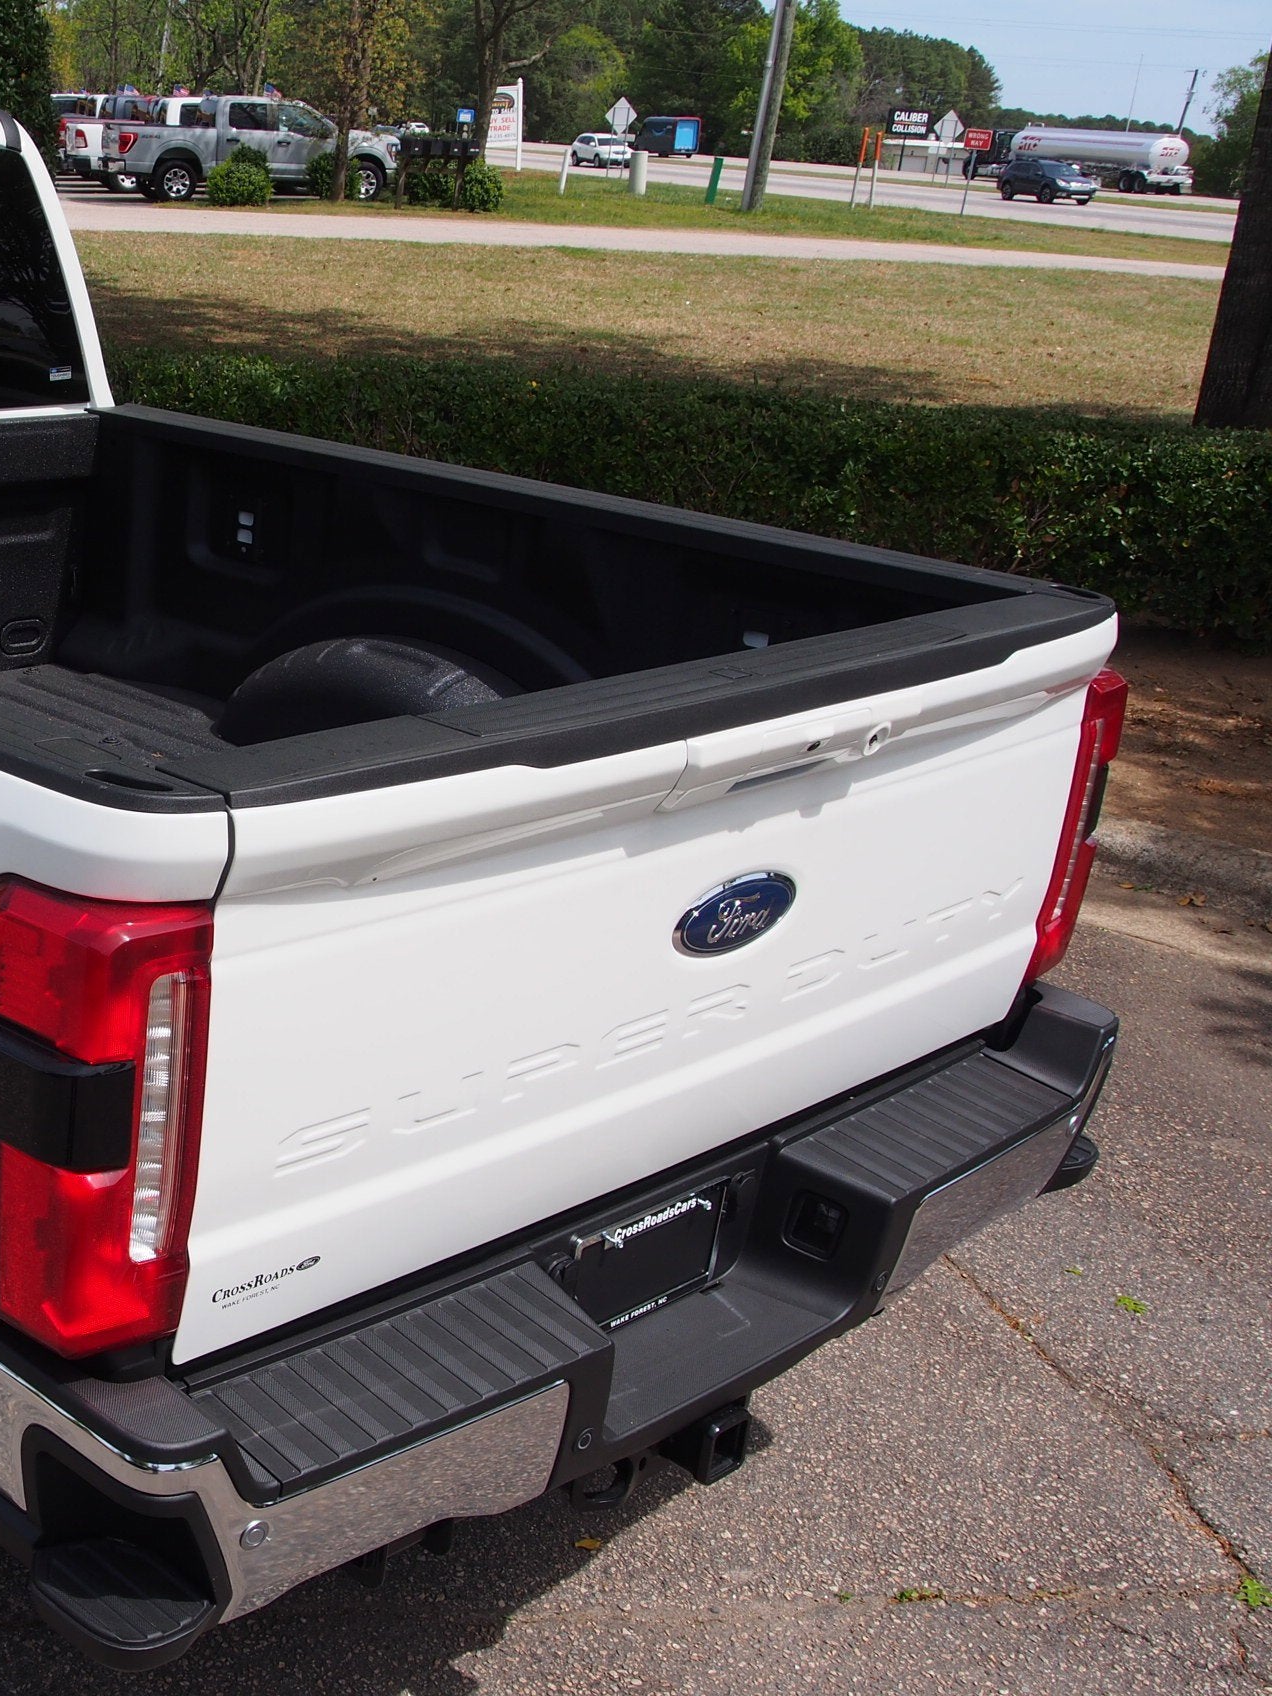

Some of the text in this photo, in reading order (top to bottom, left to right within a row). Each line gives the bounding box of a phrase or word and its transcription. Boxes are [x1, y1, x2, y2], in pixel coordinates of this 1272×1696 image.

[892, 123, 927, 134] COLLISION
[894, 111, 929, 123] CALIBER
[968, 132, 989, 140] WRONG
[707, 892, 775, 944] Ford
[272, 876, 1026, 1178] SUPER DUTY
[614, 1196, 697, 1241] CrossRoadsCars
[221, 1299, 240, 1310] WAKE
[270, 1283, 280, 1292] NC
[610, 1296, 668, 1328] WAKE FOREST, NC
